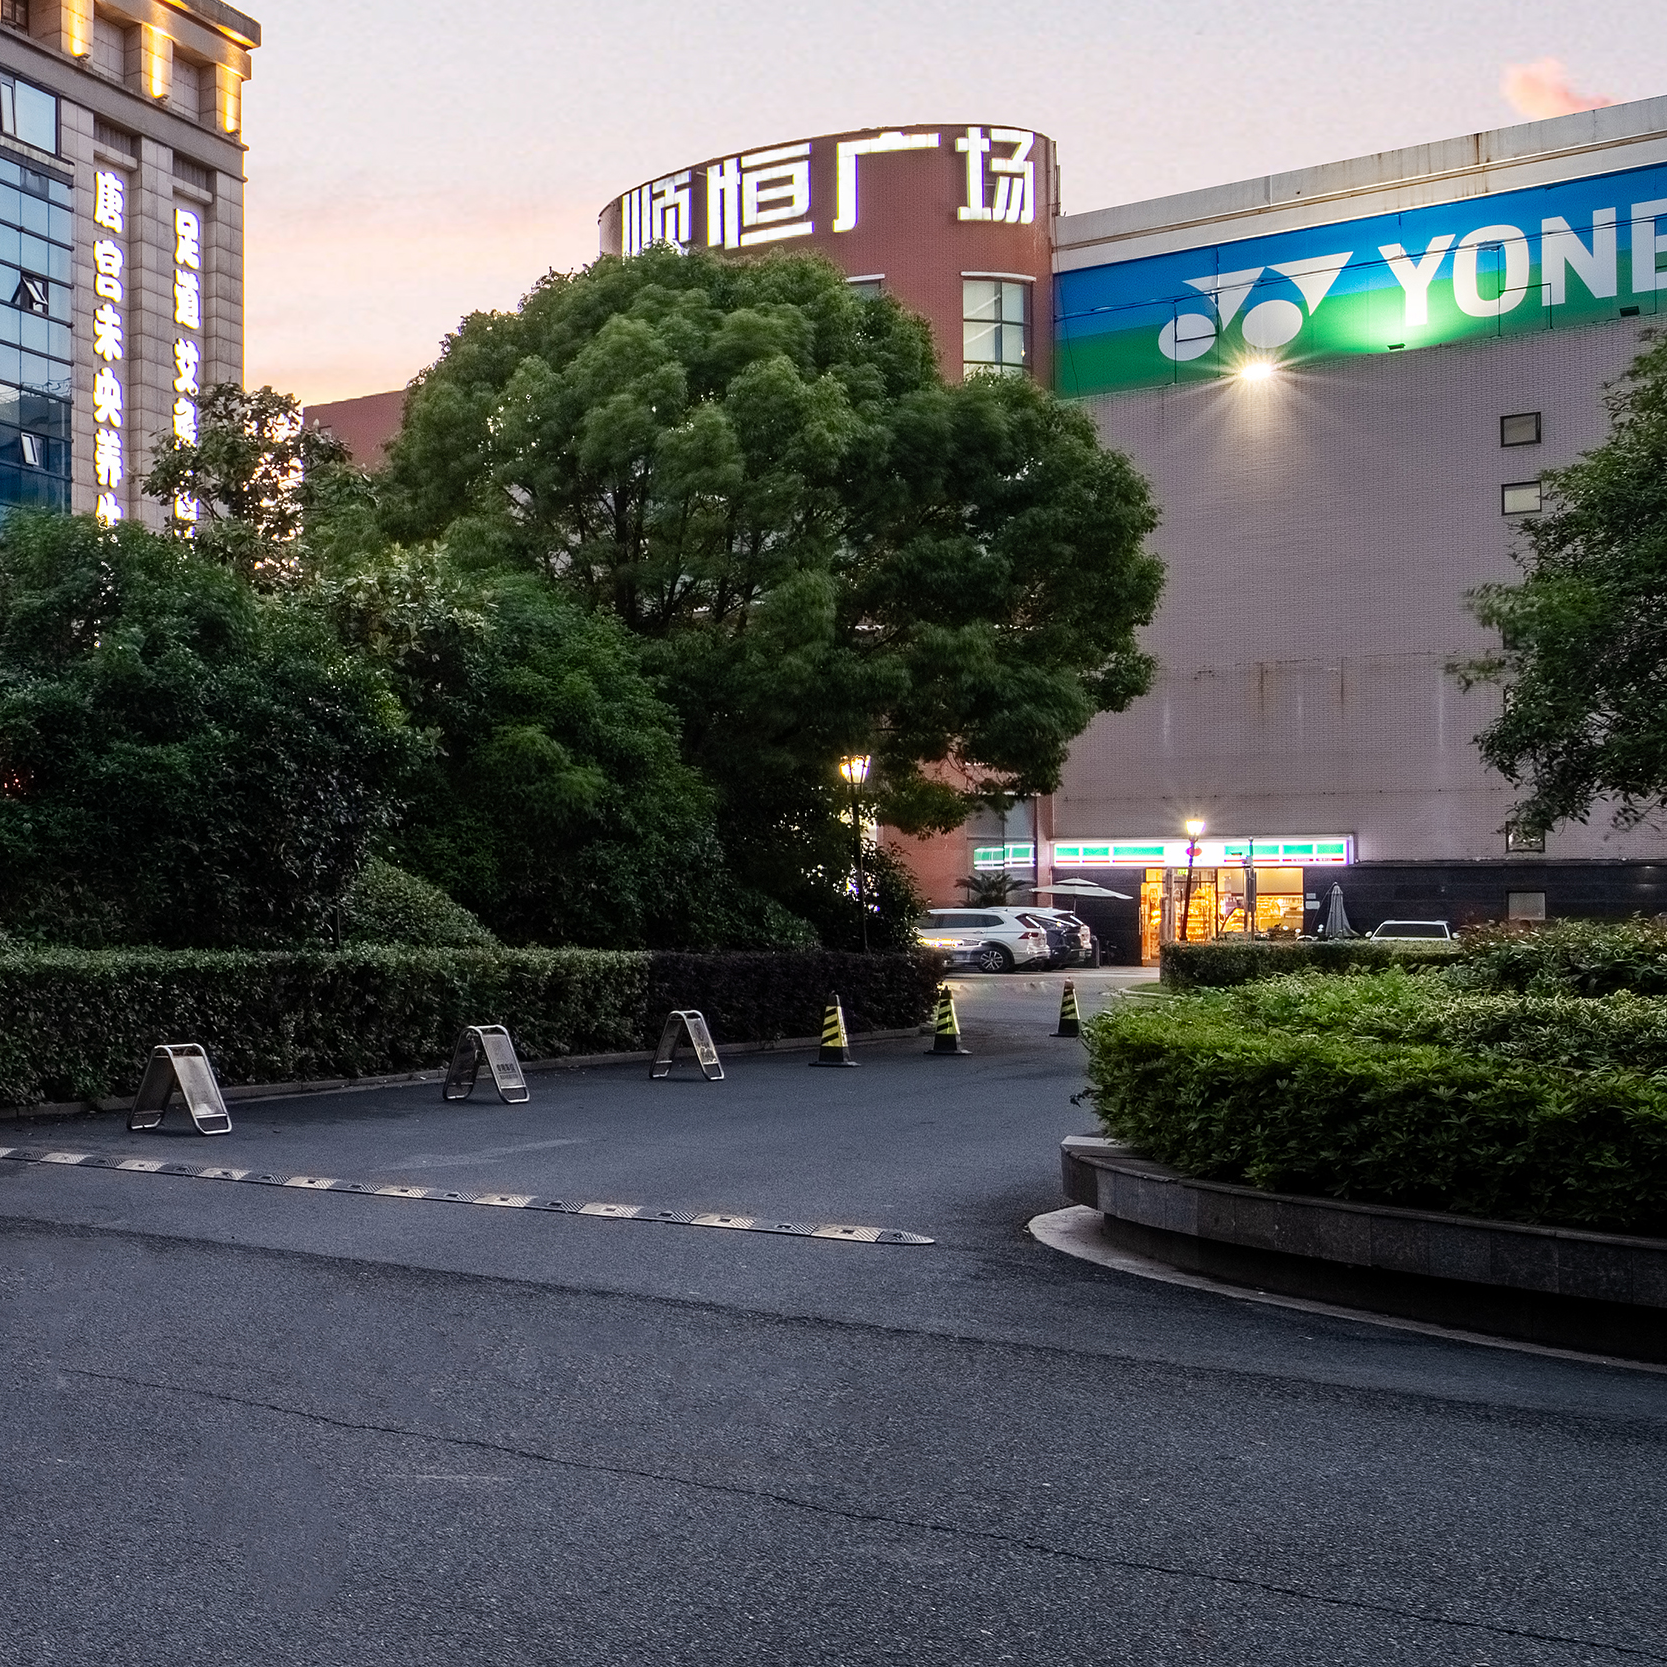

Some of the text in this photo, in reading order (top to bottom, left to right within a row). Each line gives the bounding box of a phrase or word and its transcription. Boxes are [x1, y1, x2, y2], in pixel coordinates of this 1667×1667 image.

[621, 127, 1035, 258] 顺恒广场
[1378, 198, 1667, 327] YONE
